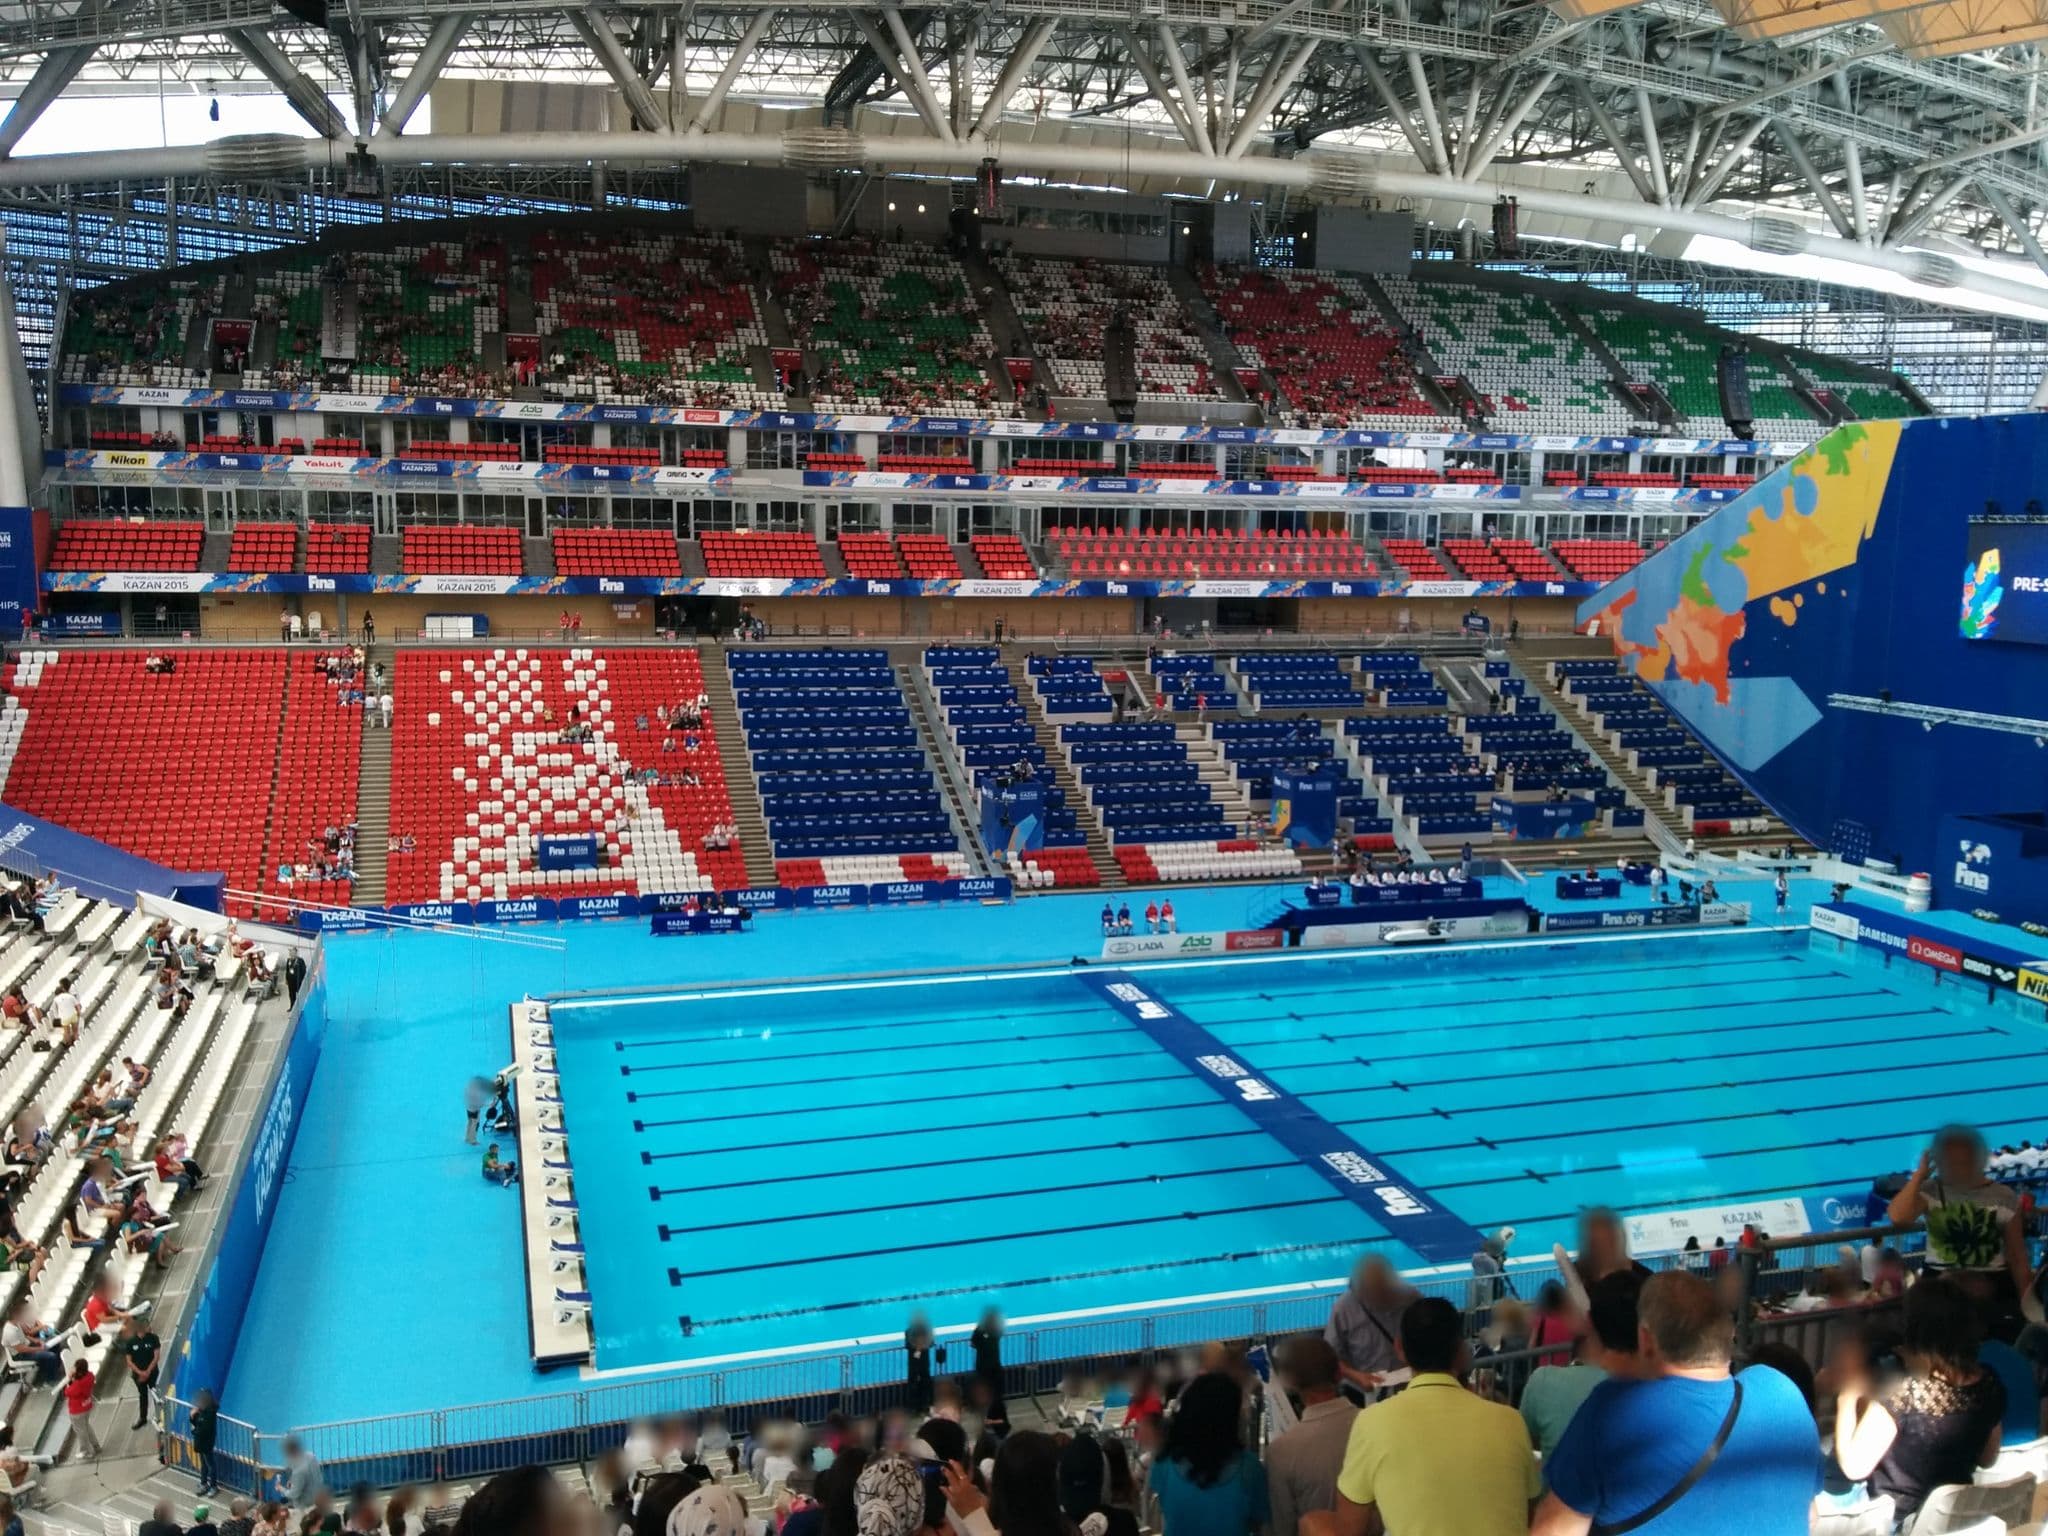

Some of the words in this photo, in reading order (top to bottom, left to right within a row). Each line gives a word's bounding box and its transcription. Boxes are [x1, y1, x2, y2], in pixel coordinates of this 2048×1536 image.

[138, 390, 170, 399] KAZAN
[258, 398, 274, 406] 2015
[348, 400, 368, 408] LADA
[436, 402, 452, 412] Fina
[1155, 428, 1167, 436] EF
[110, 455, 146, 465] Nikon
[220, 455, 238, 466] Fina
[304, 460, 344, 468] Yakult
[401, 464, 422, 472] KAZAN
[594, 467, 610, 477] Fina
[955, 476, 970, 486] Fina
[123, 581, 162, 590] KAZAN
[164, 581, 189, 590] 2015
[308, 575, 336, 590] Fina
[600, 578, 624, 592] Fina
[868, 580, 890, 593] Fina
[1107, 581, 1128, 594] Fina
[437, 584, 472, 592] KAZAN
[474, 584, 496, 592] 2015
[974, 586, 1002, 594] KAZAN
[1004, 586, 1022, 594] 2015
[1332, 582, 1352, 594] Fina
[1450, 586, 1464, 594] 2015
[1546, 582, 1564, 595] Fina
[66, 616, 102, 624] KAZAN
[548, 846, 566, 856] Fina
[1955, 860, 1990, 890] Fina
[888, 884, 924, 894] KAZAN
[959, 880, 994, 890] KAZAN
[738, 891, 776, 901] KAZAN
[814, 888, 850, 898] KAZAN
[496, 902, 537, 912] KAZAN
[579, 898, 619, 909] KAZAN
[322, 910, 366, 922] KAZAN
[410, 906, 452, 917] KAZAN
[1704, 908, 1728, 916] KAZAN
[1814, 910, 1837, 923] KAZAN
[1602, 912, 1645, 926] Fina.org
[1858, 925, 1908, 950] SAMSUNG
[1138, 942, 1164, 951] LADA
[1923, 948, 1958, 966] OMEGA
[1963, 958, 1992, 976] arena
[1722, 1210, 1764, 1225] KAZAN
